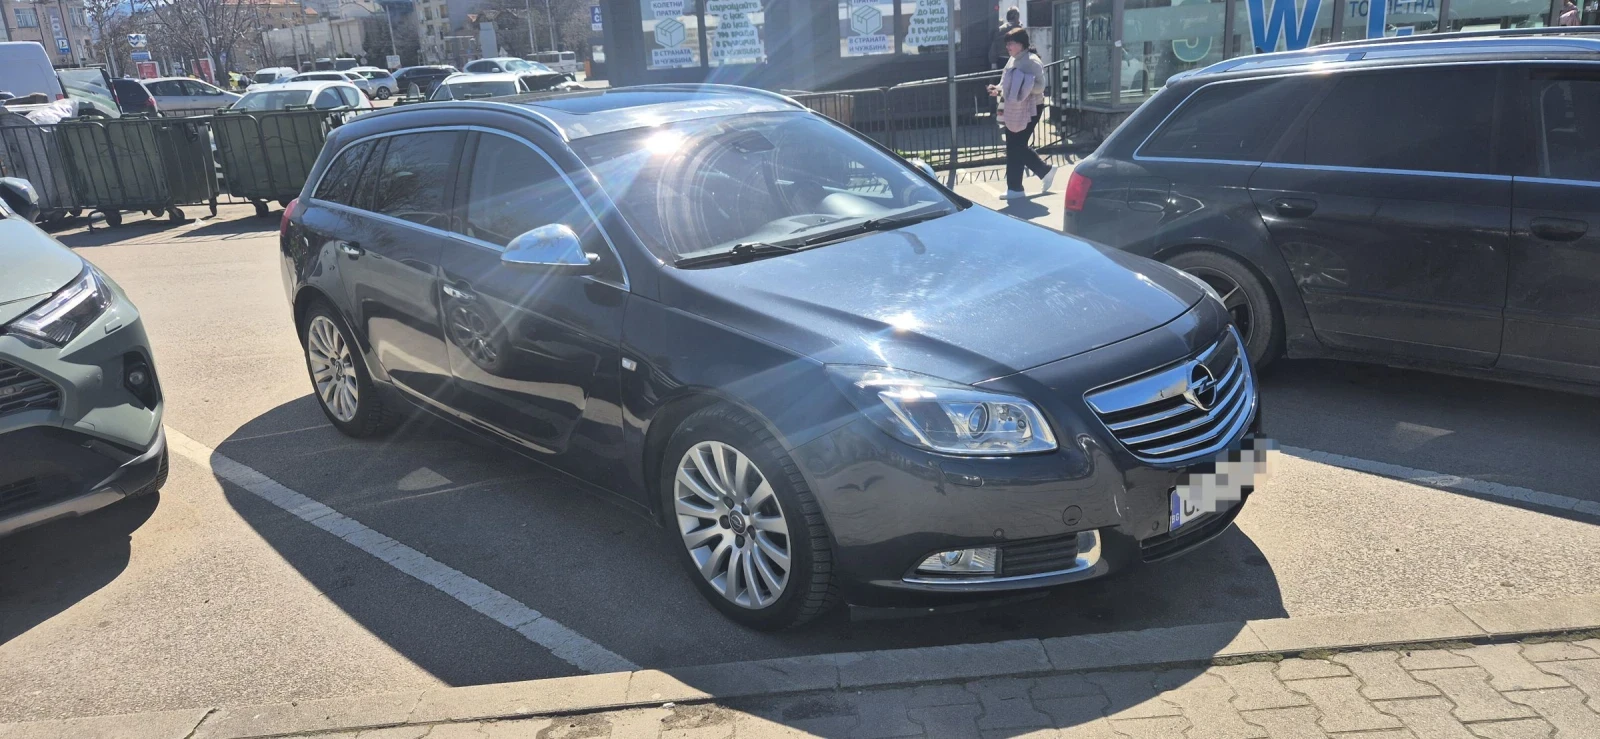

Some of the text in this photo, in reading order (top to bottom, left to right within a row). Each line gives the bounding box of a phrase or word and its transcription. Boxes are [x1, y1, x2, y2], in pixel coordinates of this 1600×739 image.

[854, 36, 886, 44] СТРАНАТА
[659, 48, 691, 56] СТРАНАТА
[855, 44, 887, 52] ЧУЖБИНА
[659, 57, 693, 65] ЧУЖБИНА
[1171, 512, 1180, 524] BG
